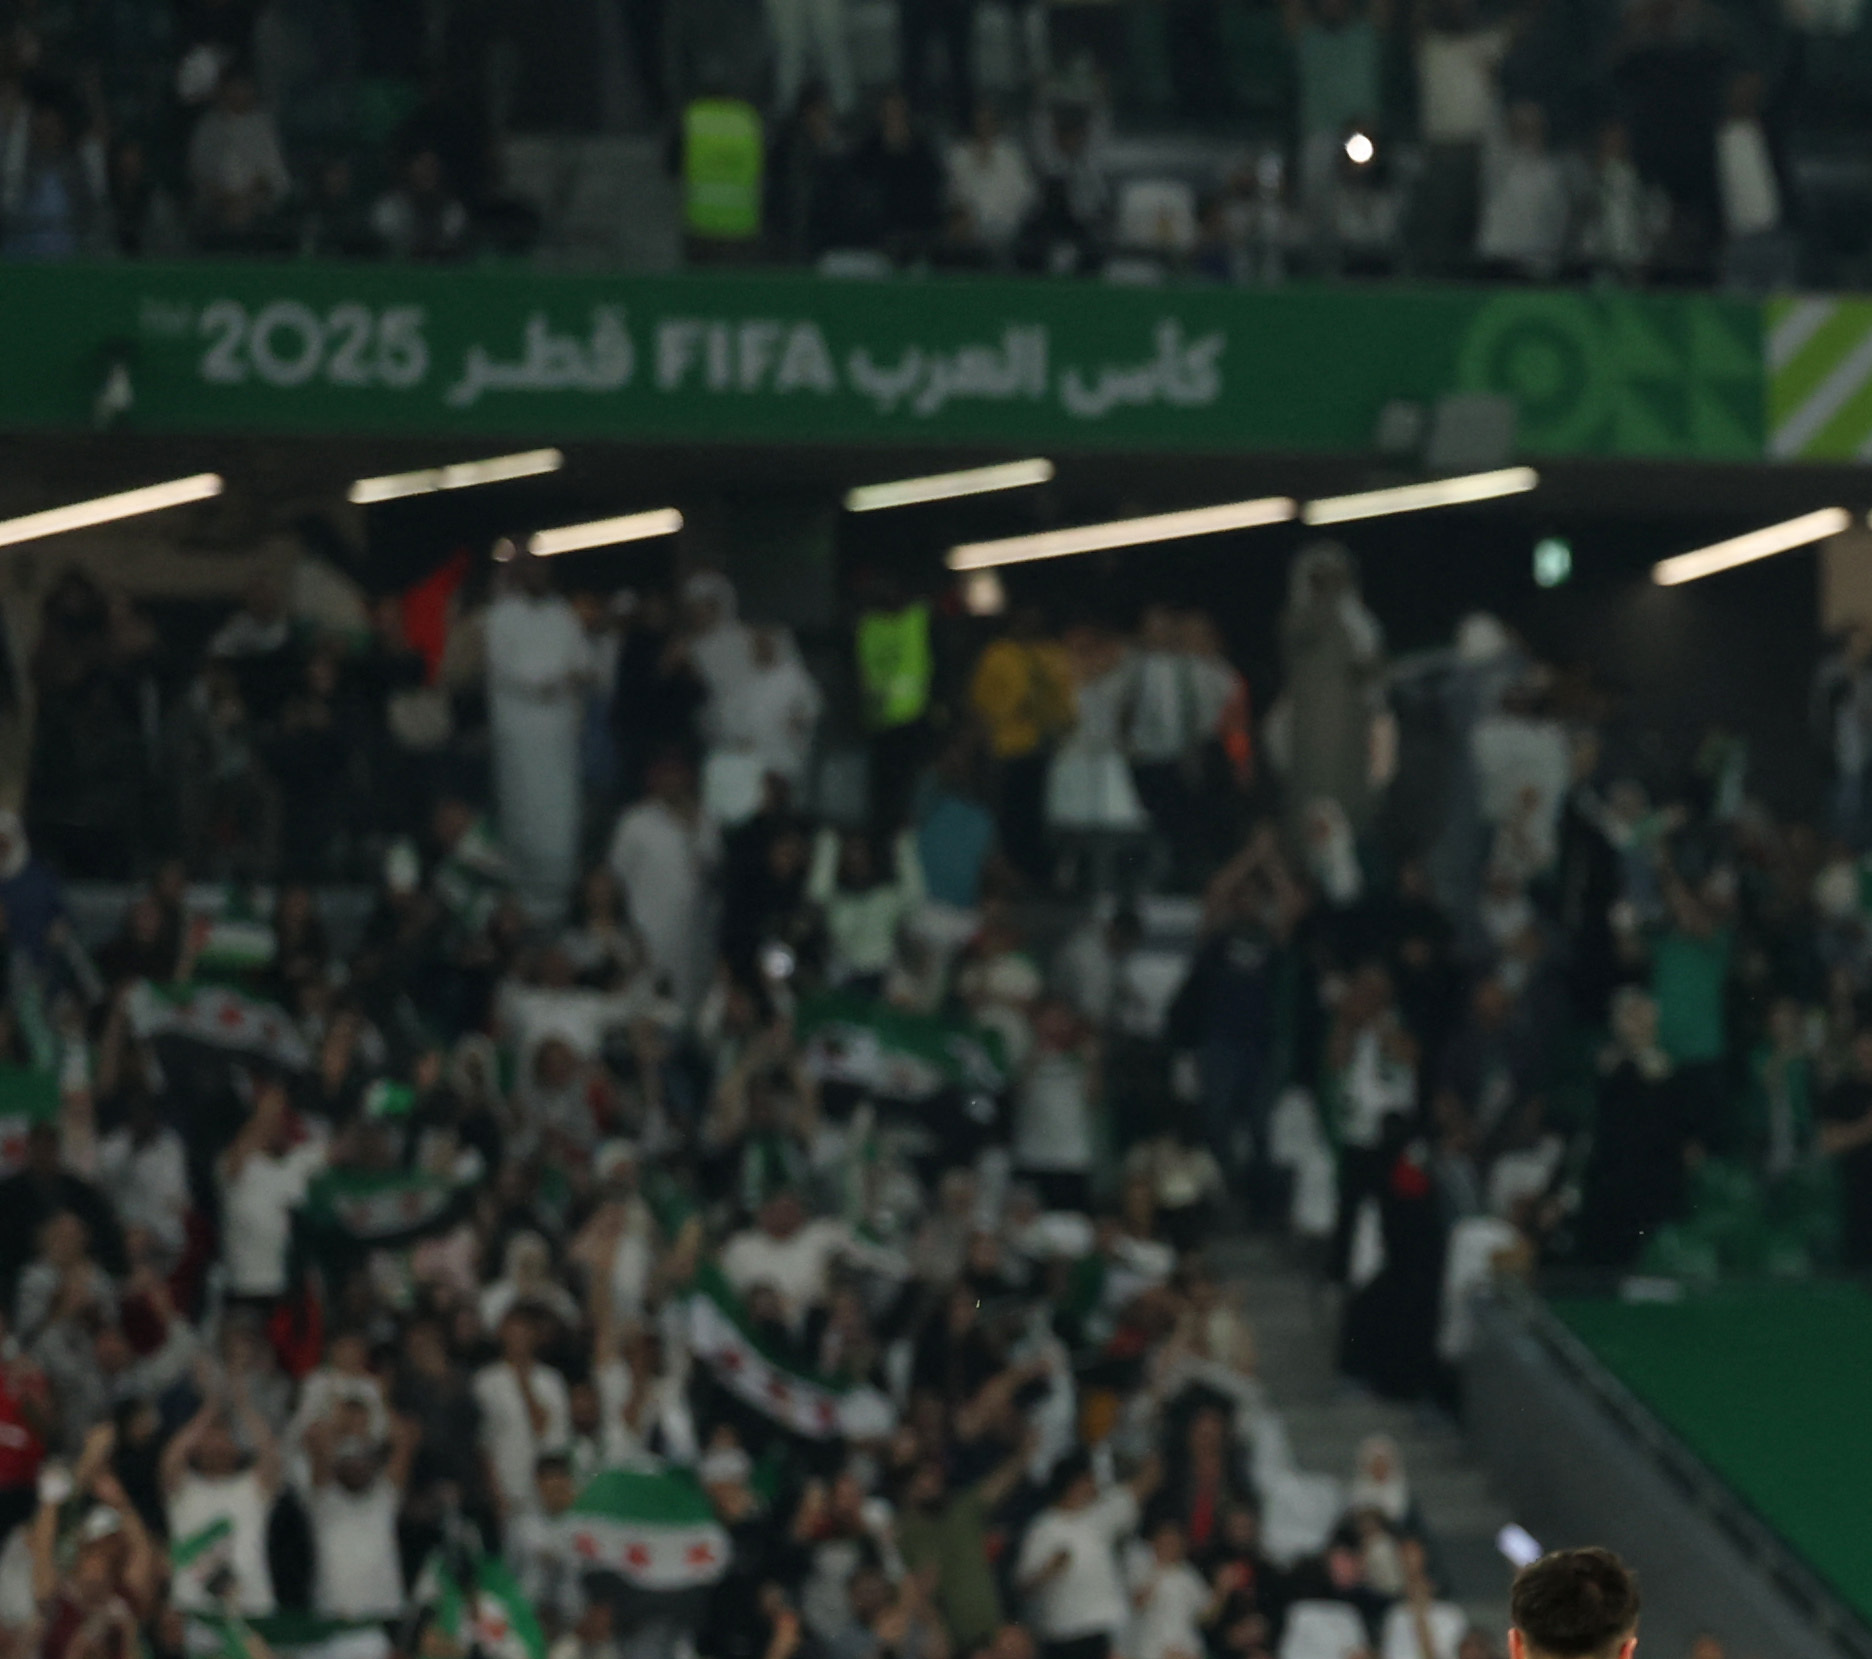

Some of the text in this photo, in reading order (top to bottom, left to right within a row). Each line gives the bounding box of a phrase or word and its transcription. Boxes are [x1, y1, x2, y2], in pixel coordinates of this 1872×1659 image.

[200, 300, 430, 386] 2025
[446, 302, 636, 408] قطر
[655, 318, 838, 394] FIFA
[845, 322, 1050, 418] العرب
